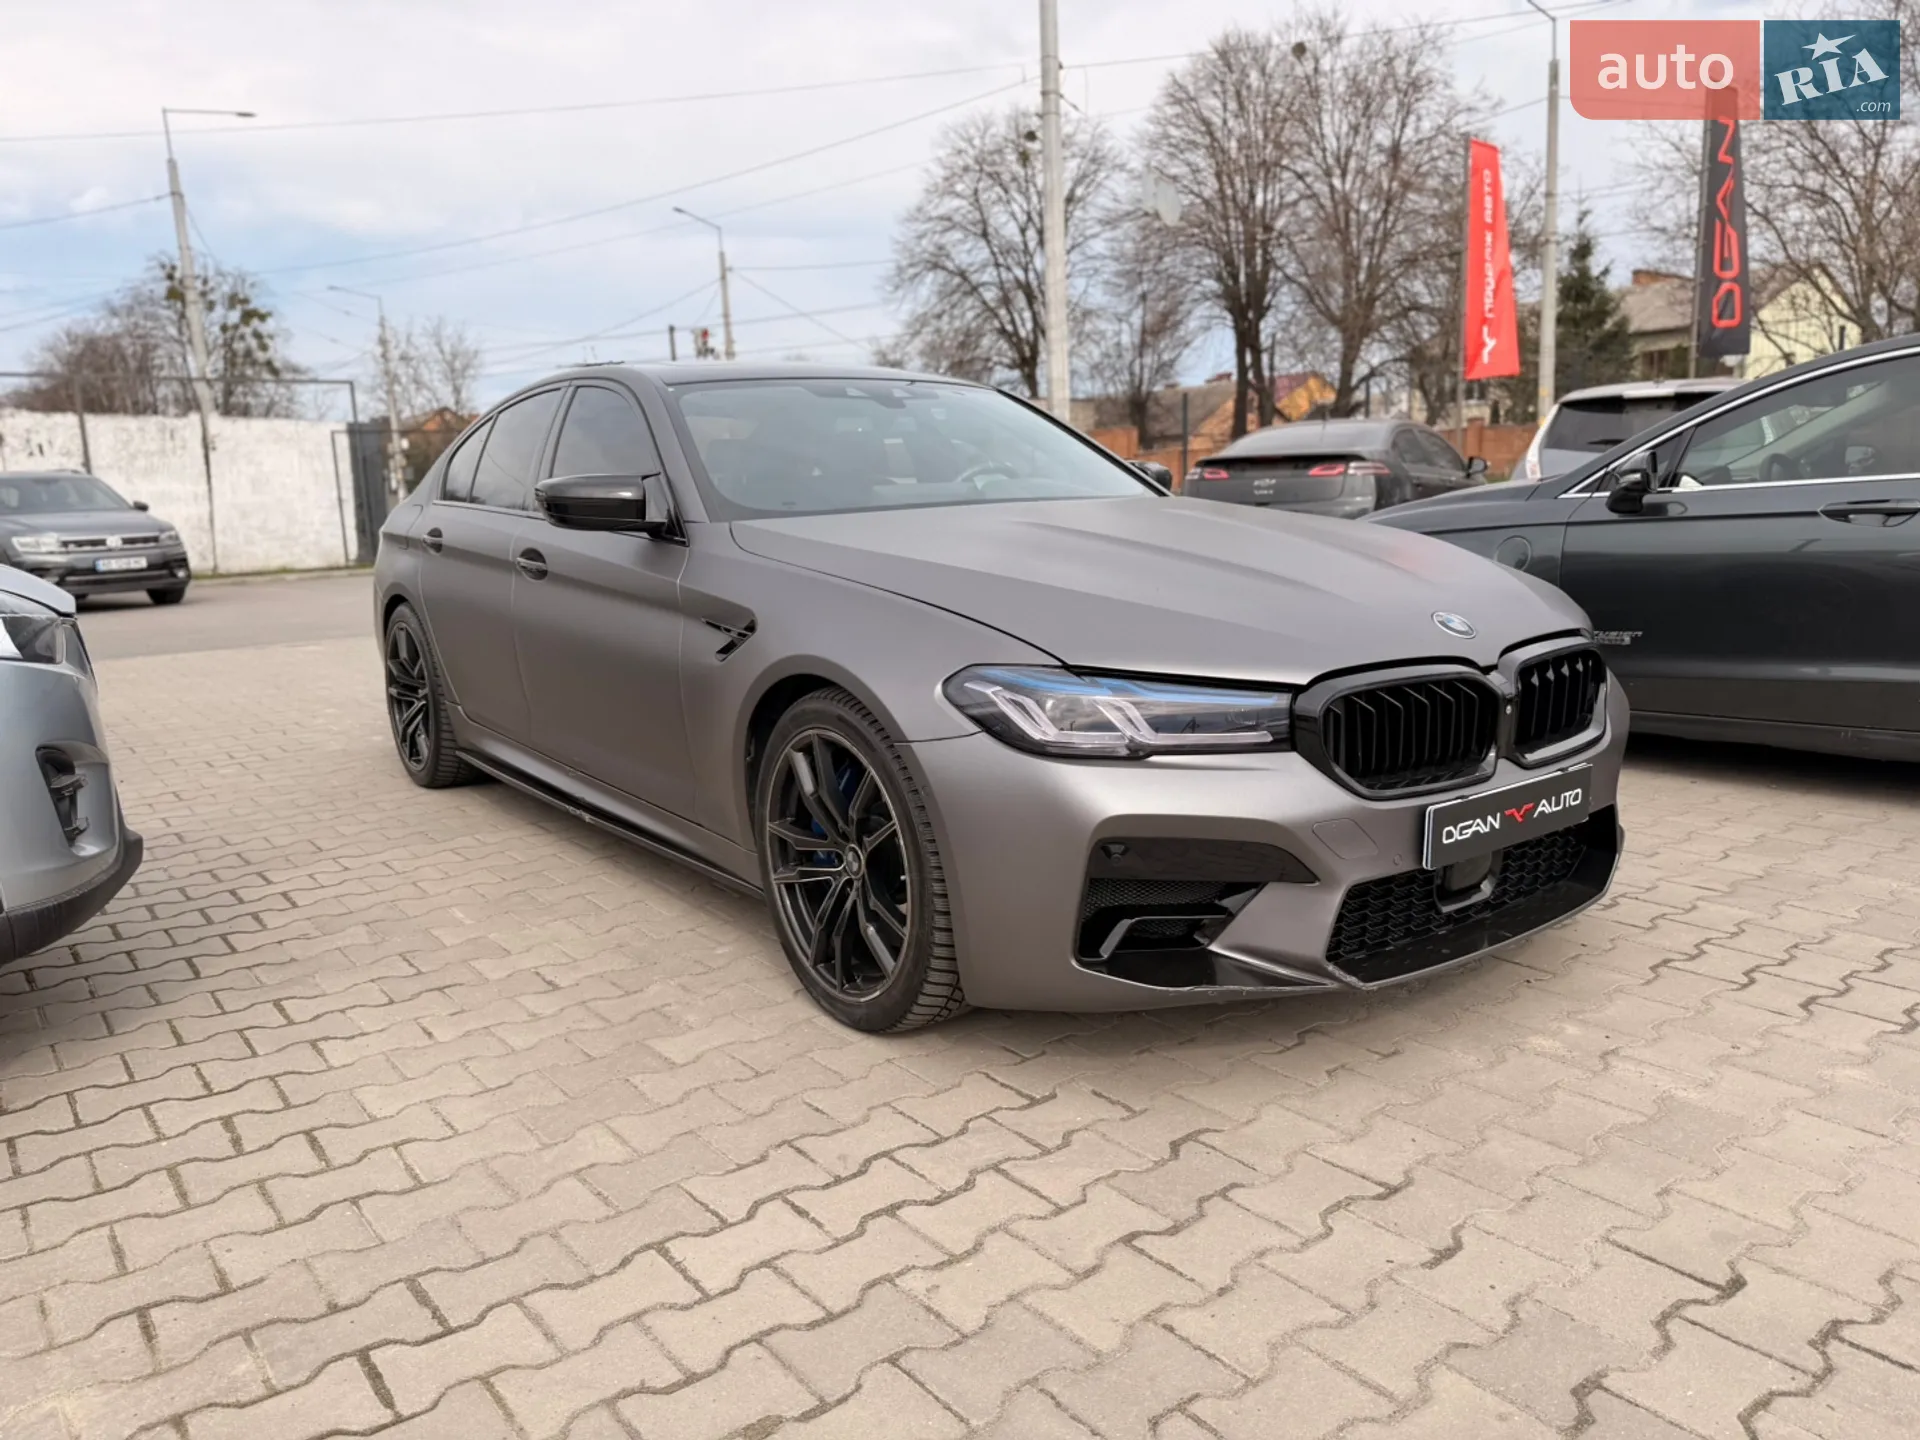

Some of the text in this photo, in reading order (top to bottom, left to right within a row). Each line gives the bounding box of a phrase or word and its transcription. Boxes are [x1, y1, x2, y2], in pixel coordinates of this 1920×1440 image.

[1711, 116, 1742, 328] OGAN
[1442, 788, 1582, 844] OGAN AUTO
